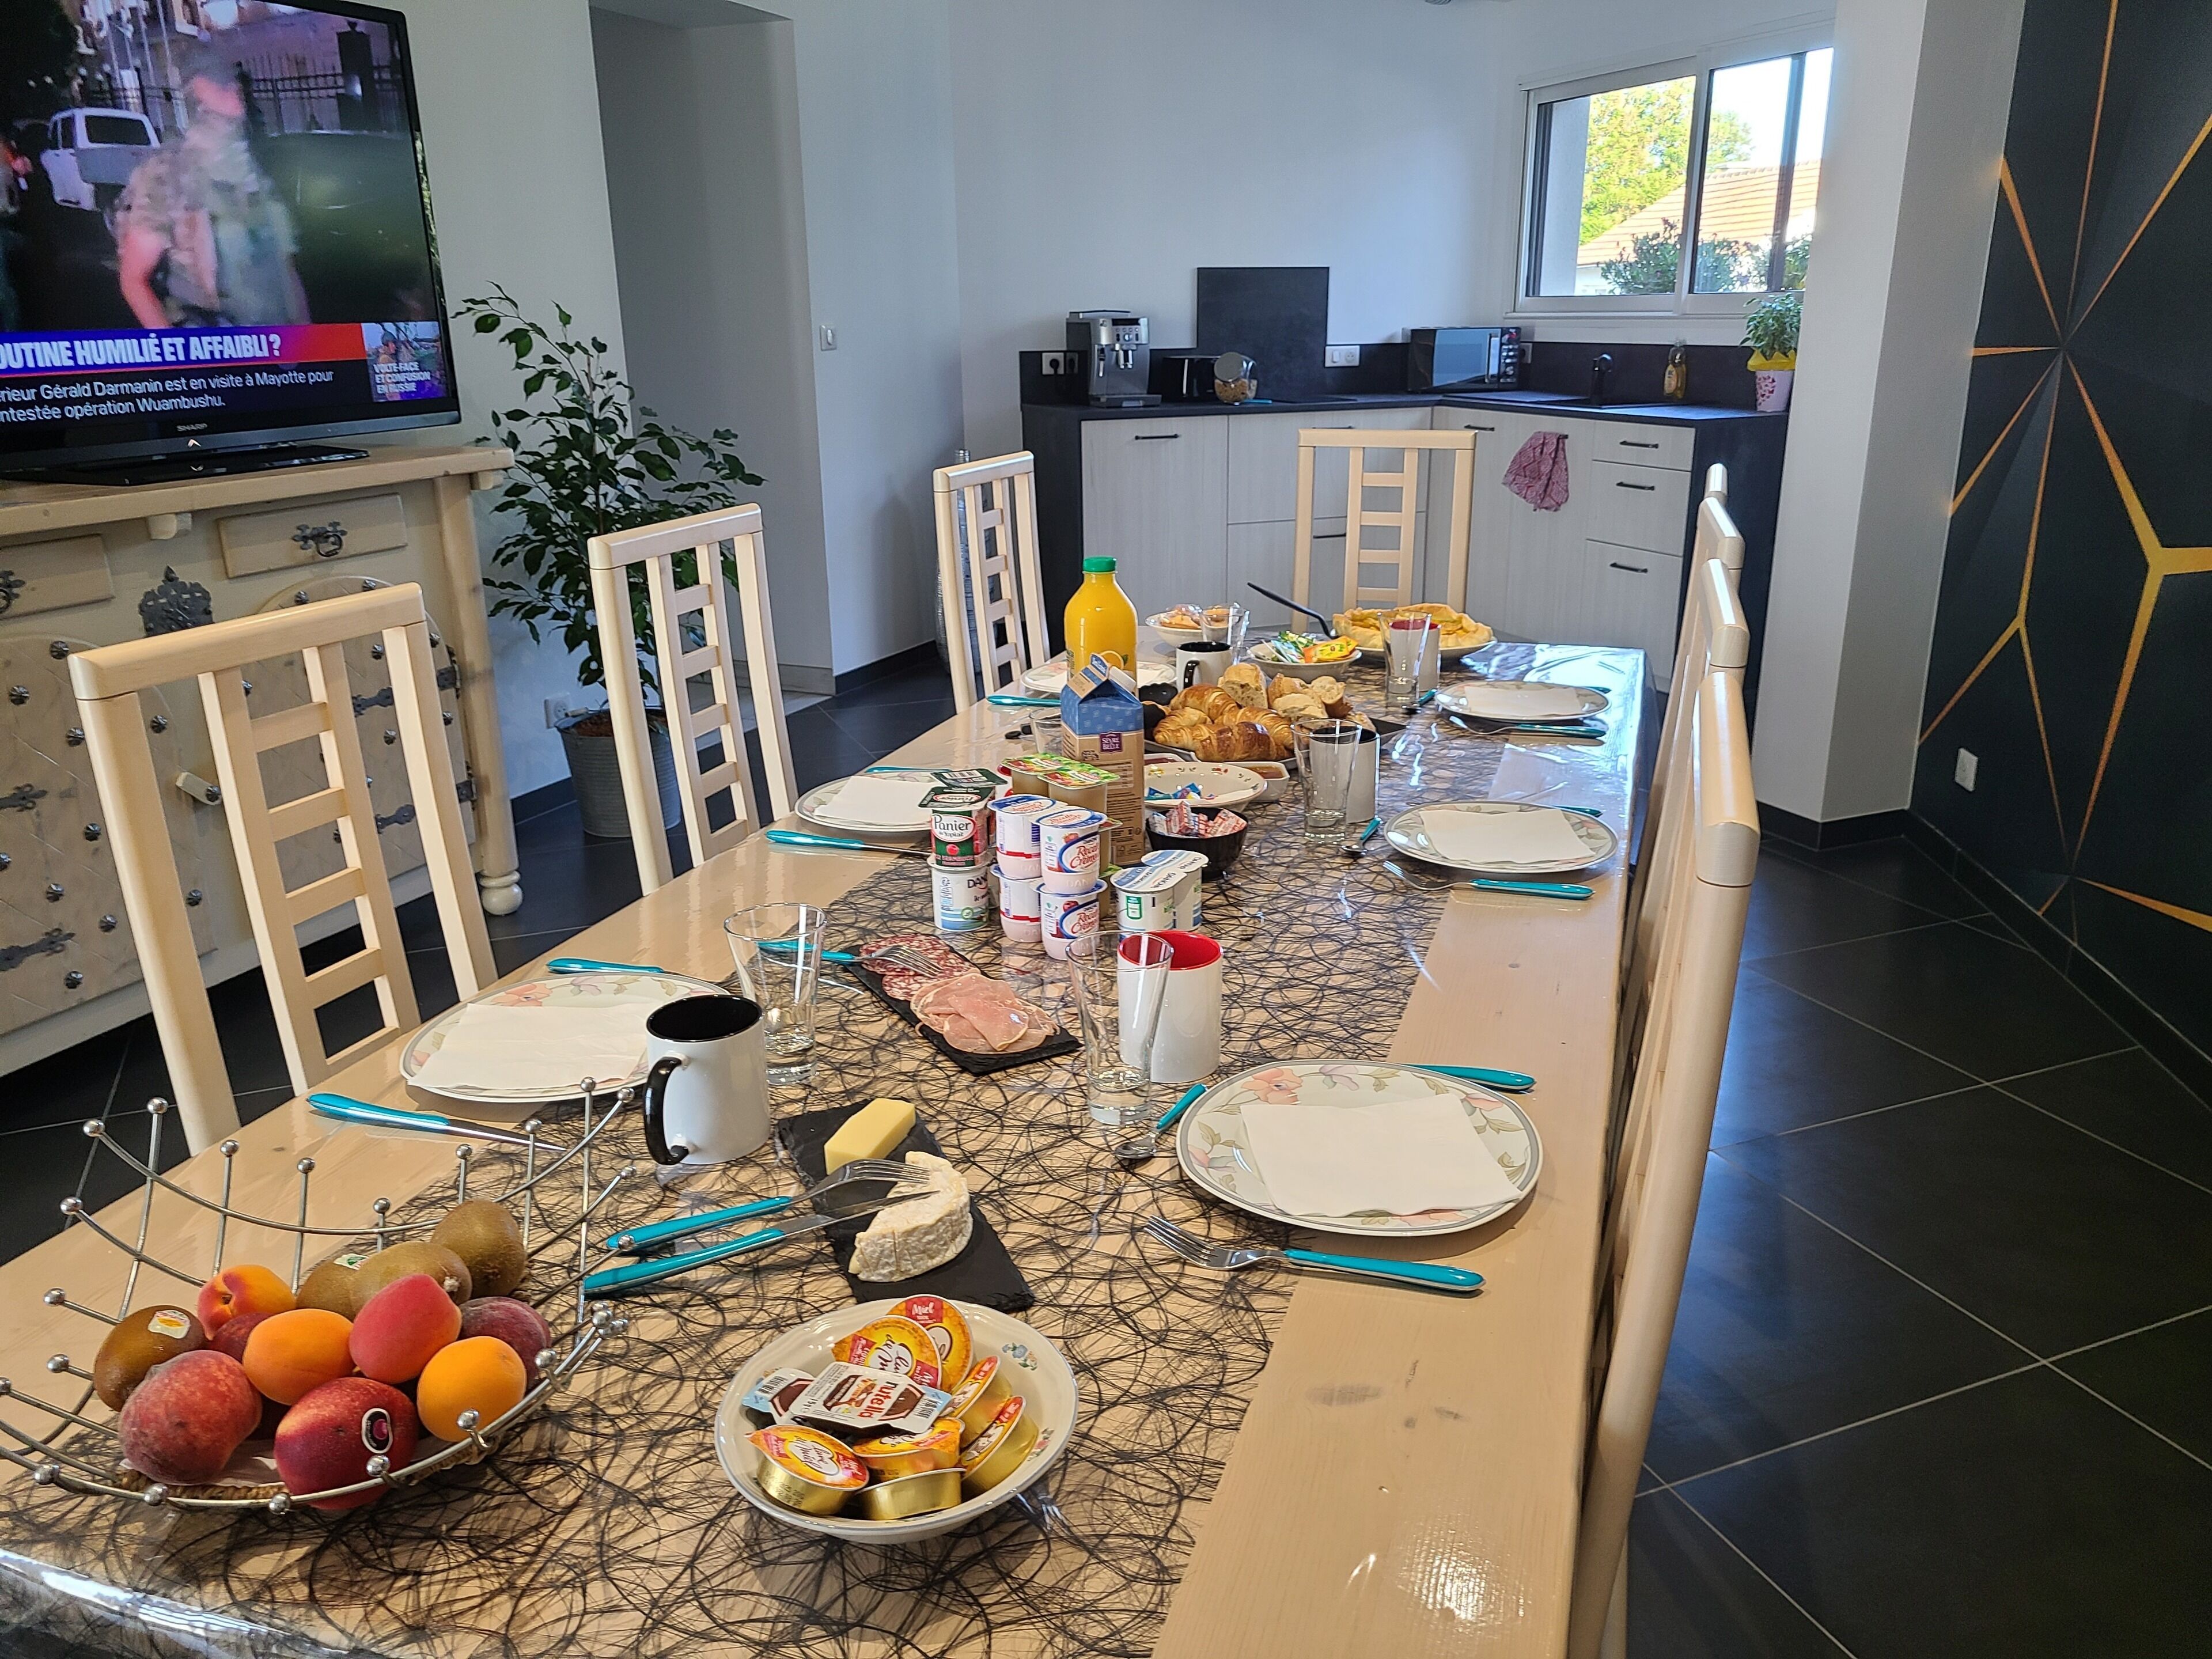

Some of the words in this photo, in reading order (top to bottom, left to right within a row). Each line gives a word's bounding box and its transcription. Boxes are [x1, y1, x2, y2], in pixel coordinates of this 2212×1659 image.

[73, 332, 162, 366] HUMILIÉ
[161, 337, 185, 362] ET
[189, 334, 269, 361] AFFAIBLI
[0, 387, 37, 402] rieur
[40, 382, 90, 400] Gérald
[93, 378, 163, 397] Darmanin
[165, 376, 188, 392] est
[190, 378, 207, 390] en
[208, 373, 244, 389] visite
[245, 373, 254, 387] à
[255, 370, 306, 388] Mayotte
[307, 371, 334, 385] pour
[64, 400, 135, 420] opération
[136, 393, 225, 412] Wuambushu.
[934, 815, 971, 831] Panier
[912, 1302, 934, 1315] Miel
[857, 1381, 895, 1419] nutella
